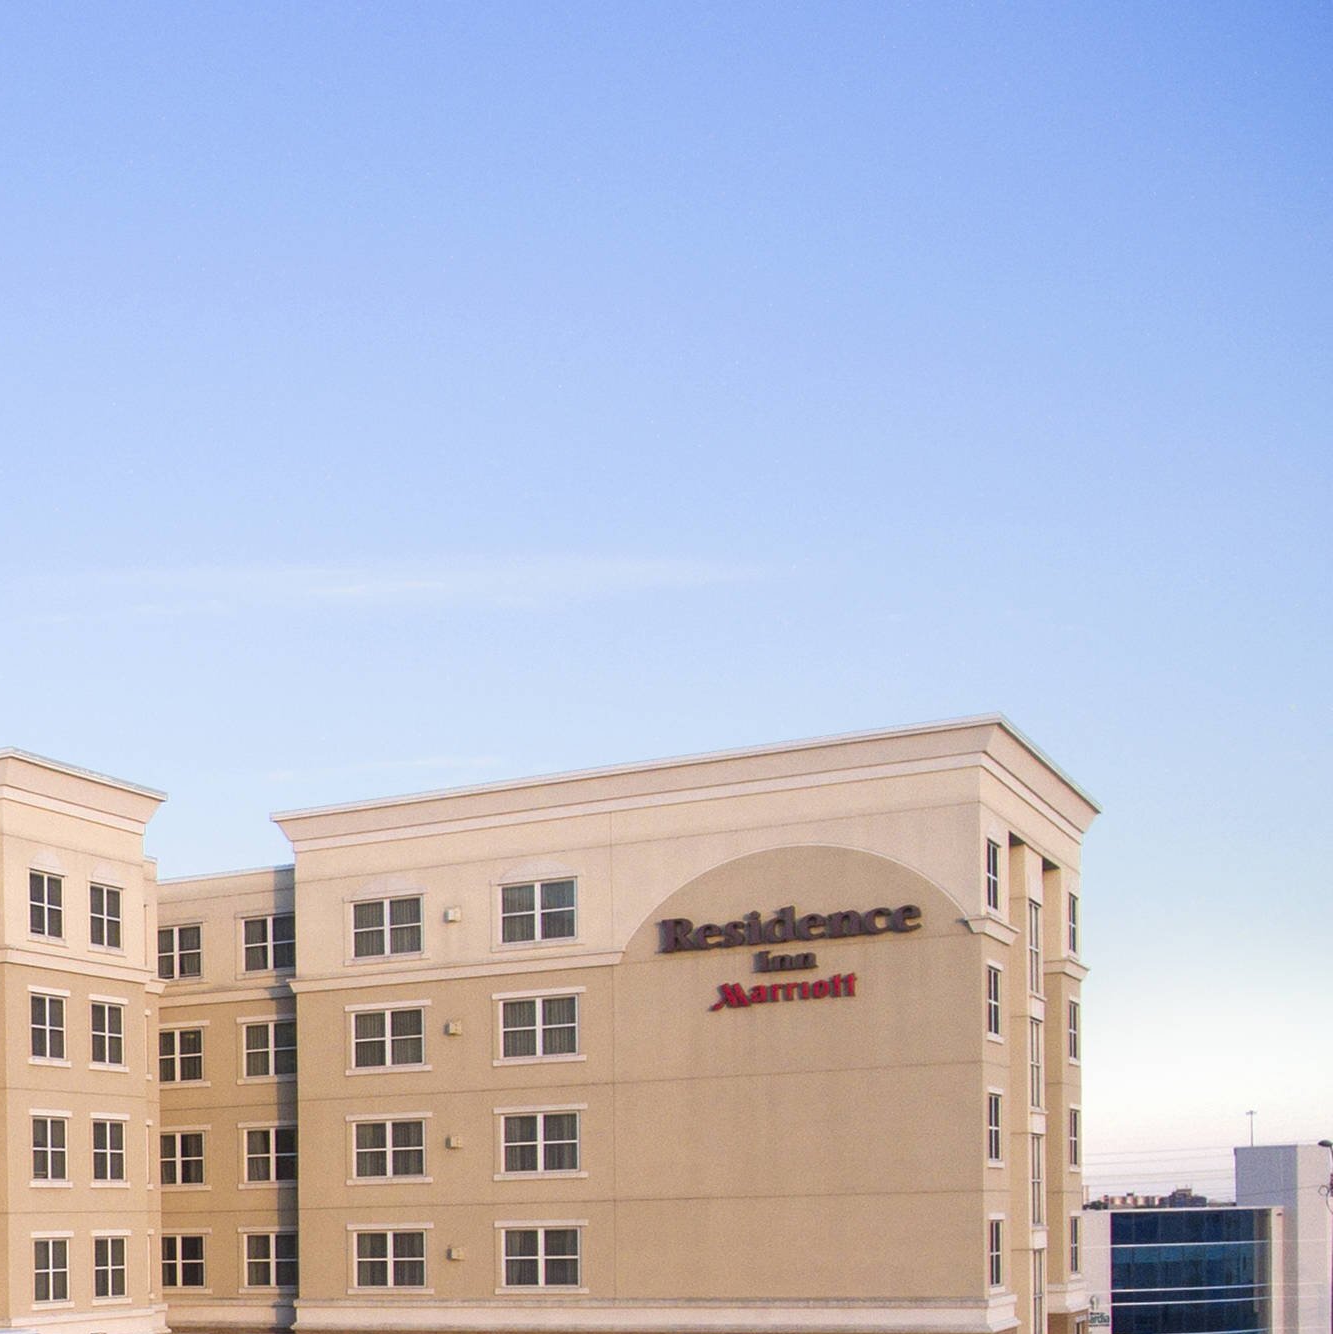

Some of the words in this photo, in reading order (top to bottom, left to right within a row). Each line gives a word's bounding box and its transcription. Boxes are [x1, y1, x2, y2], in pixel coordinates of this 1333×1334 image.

[656, 905, 923, 953] Residence
[754, 951, 817, 972] Inn
[708, 973, 856, 1011] Marriott
